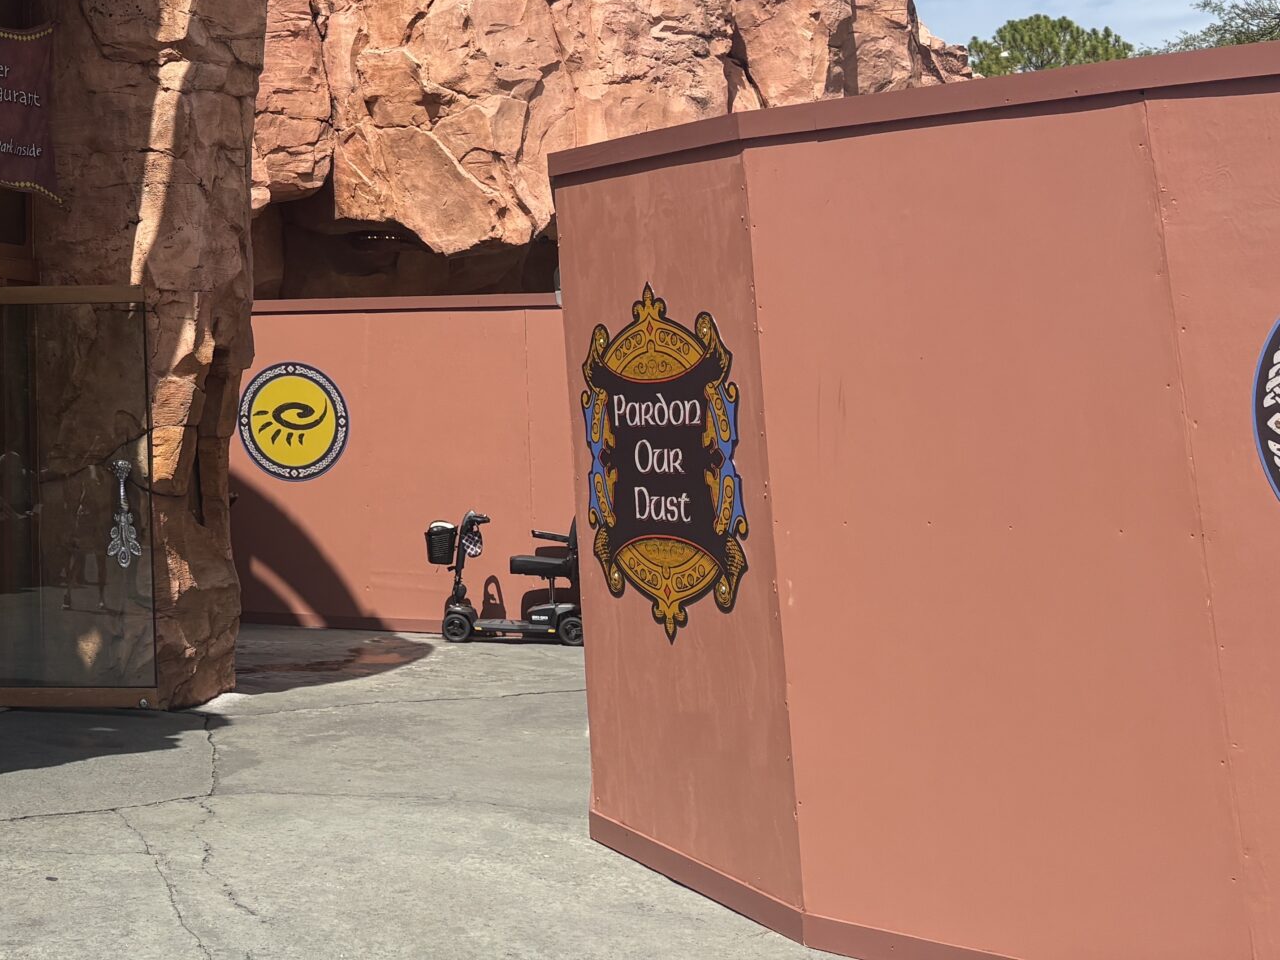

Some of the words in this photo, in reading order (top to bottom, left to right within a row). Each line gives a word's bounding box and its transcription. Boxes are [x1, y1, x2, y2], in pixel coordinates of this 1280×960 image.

[613, 393, 701, 427] Pardon
[634, 439, 685, 473] Our
[634, 486, 691, 522] Dust
